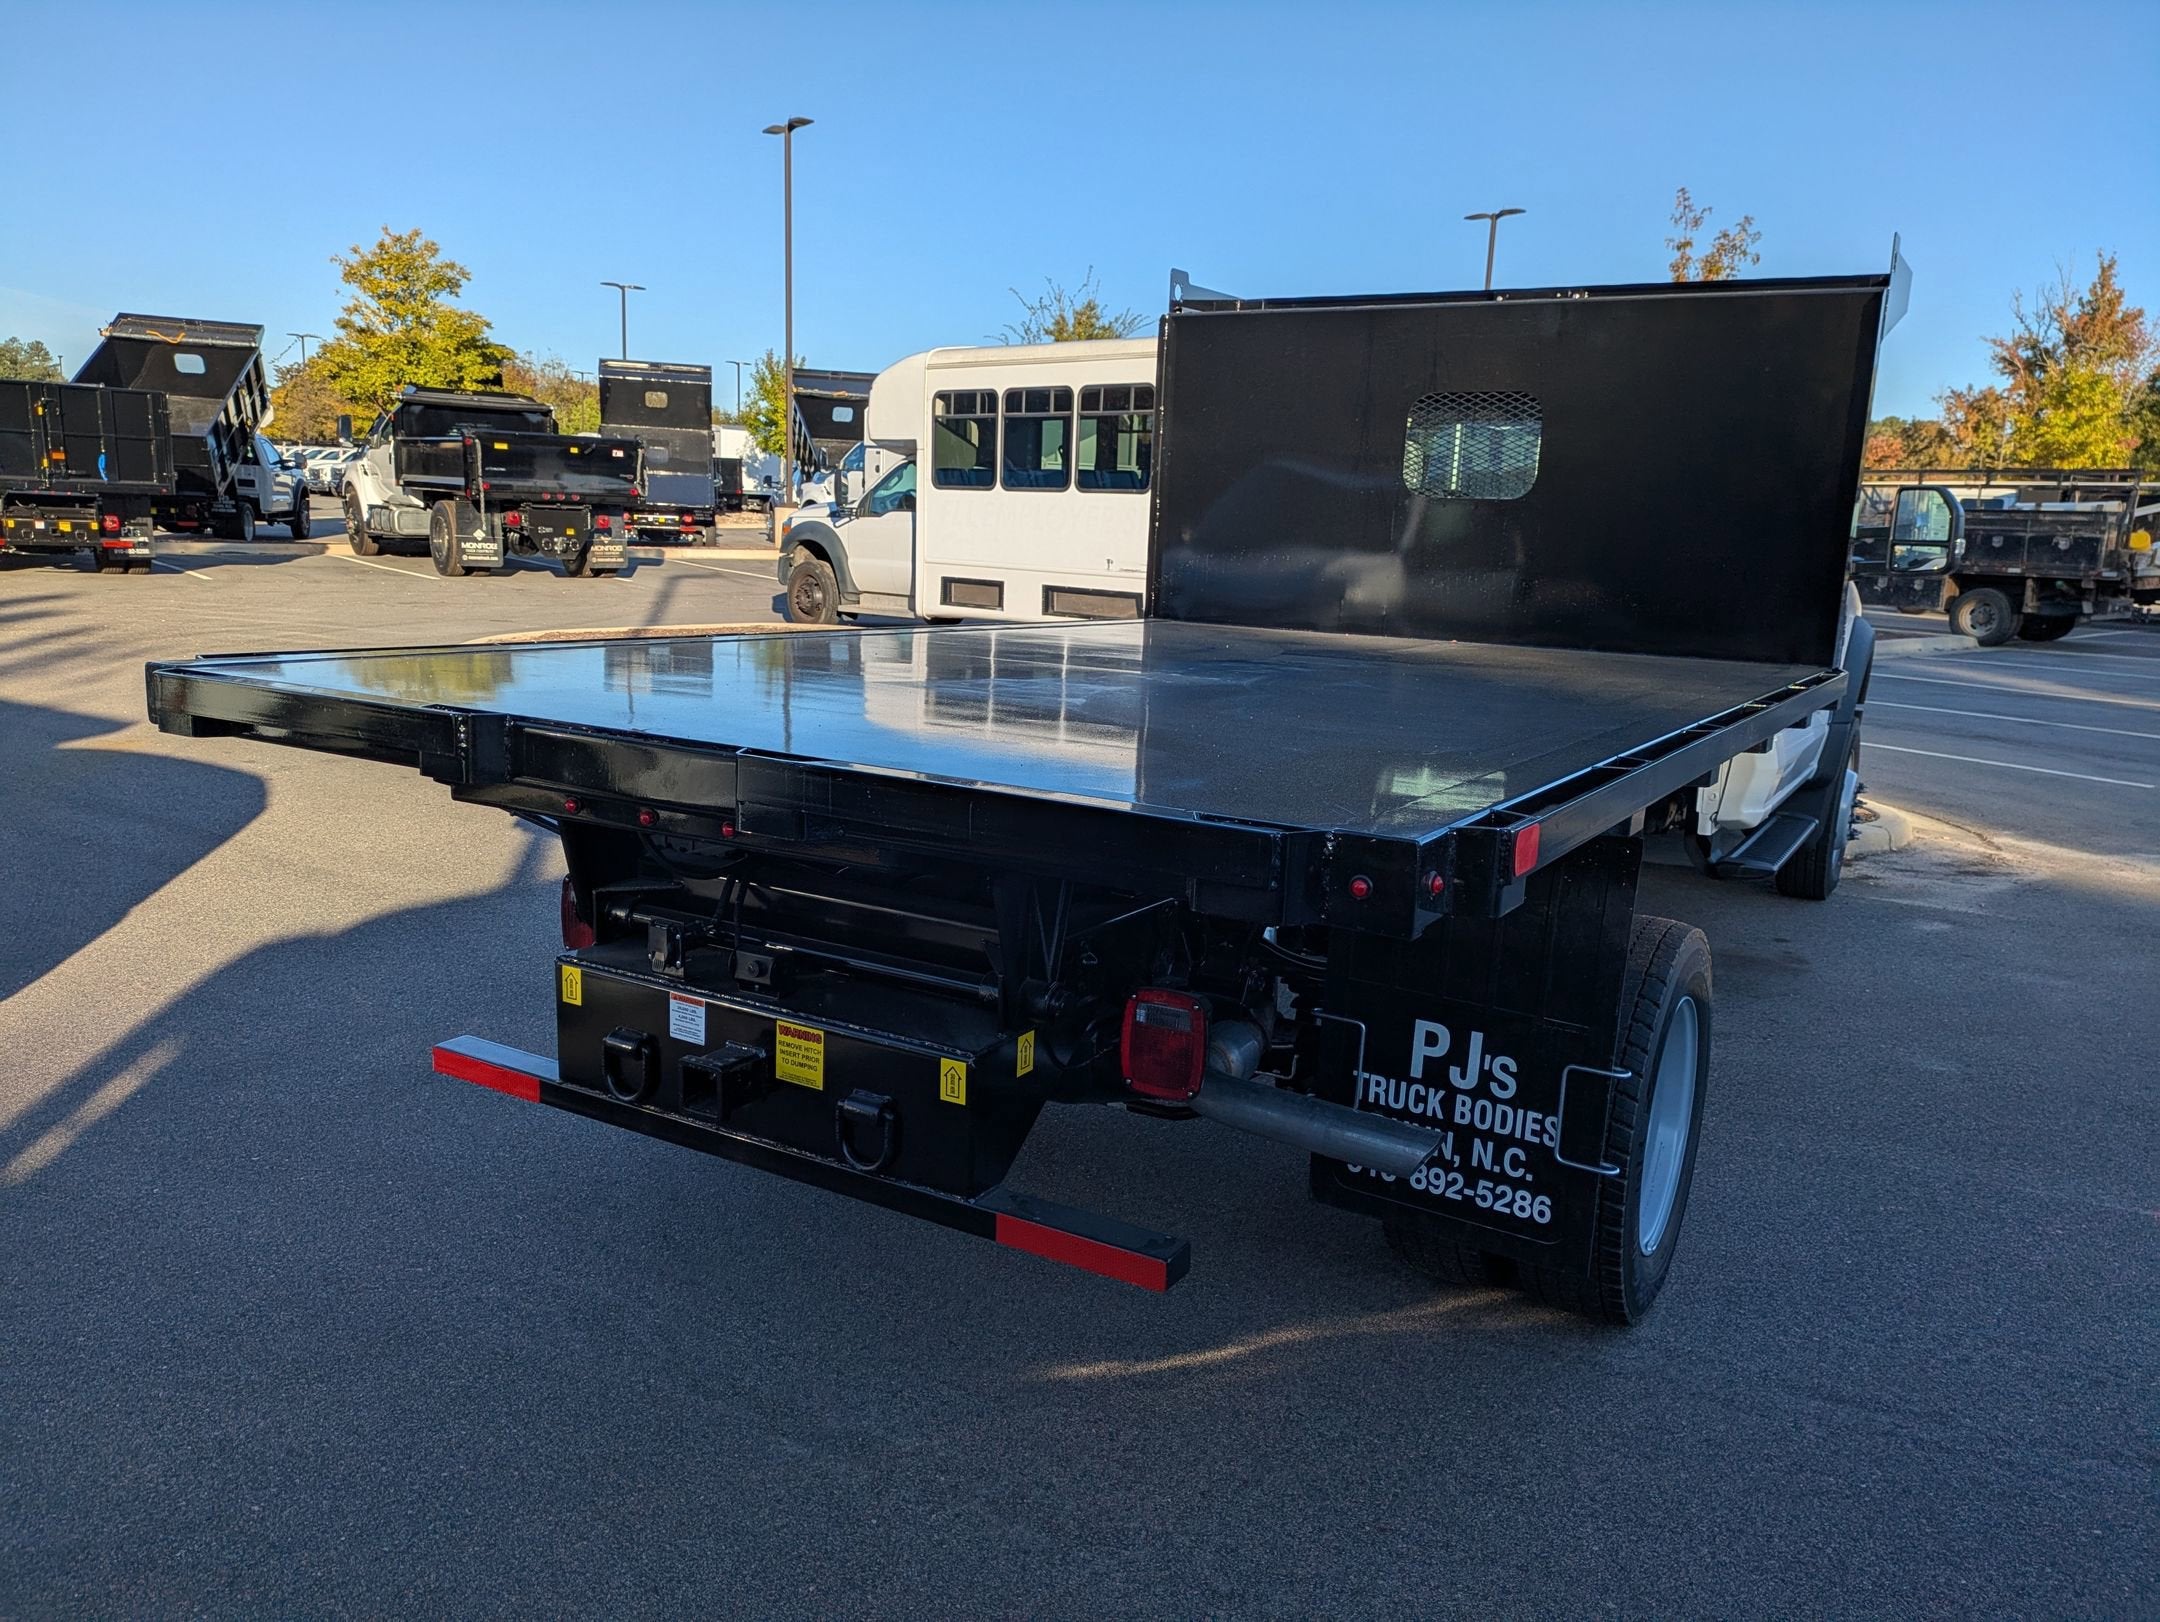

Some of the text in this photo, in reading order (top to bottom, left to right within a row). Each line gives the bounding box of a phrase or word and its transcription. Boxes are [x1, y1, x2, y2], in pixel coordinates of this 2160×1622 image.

[778, 1023, 823, 1045] WARNING
[778, 1039, 822, 1057] REMOVE HITCH
[779, 1048, 820, 1064] INSERT PRIOR
[781, 1057, 818, 1072] TO DUMPING
[1352, 1070, 1446, 1120] TRUCK
[1453, 1093, 1560, 1148] BODIES
[1471, 1137, 1534, 1182] N.C.
